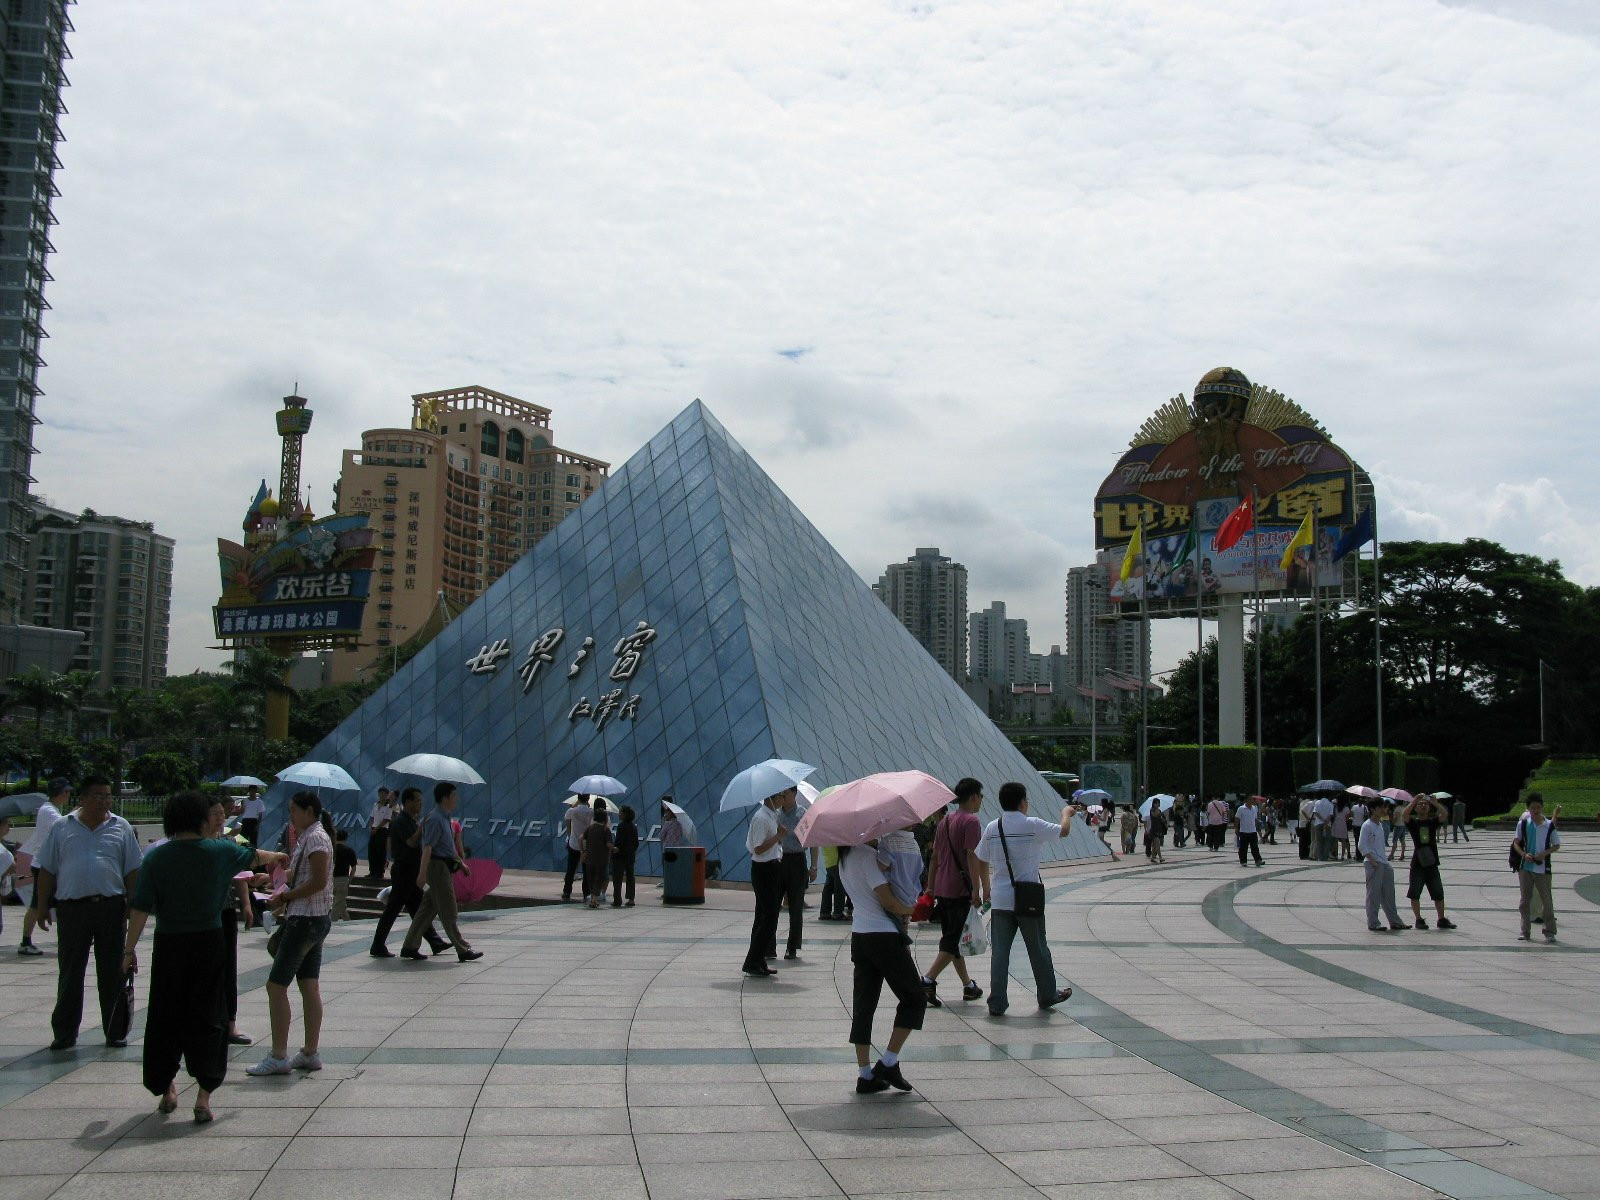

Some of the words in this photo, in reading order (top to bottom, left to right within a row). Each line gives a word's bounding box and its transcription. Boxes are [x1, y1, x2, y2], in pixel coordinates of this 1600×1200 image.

[1121, 462, 1189, 485] Window
[1198, 454, 1220, 480] of
[1219, 454, 1245, 473] the
[1254, 445, 1323, 468] World
[350, 496, 383, 504] CROWNE
[405, 491, 420, 591] 深圳威尼斯酒店
[275, 572, 352, 600] 欢乐谷
[488, 817, 547, 837] THE
